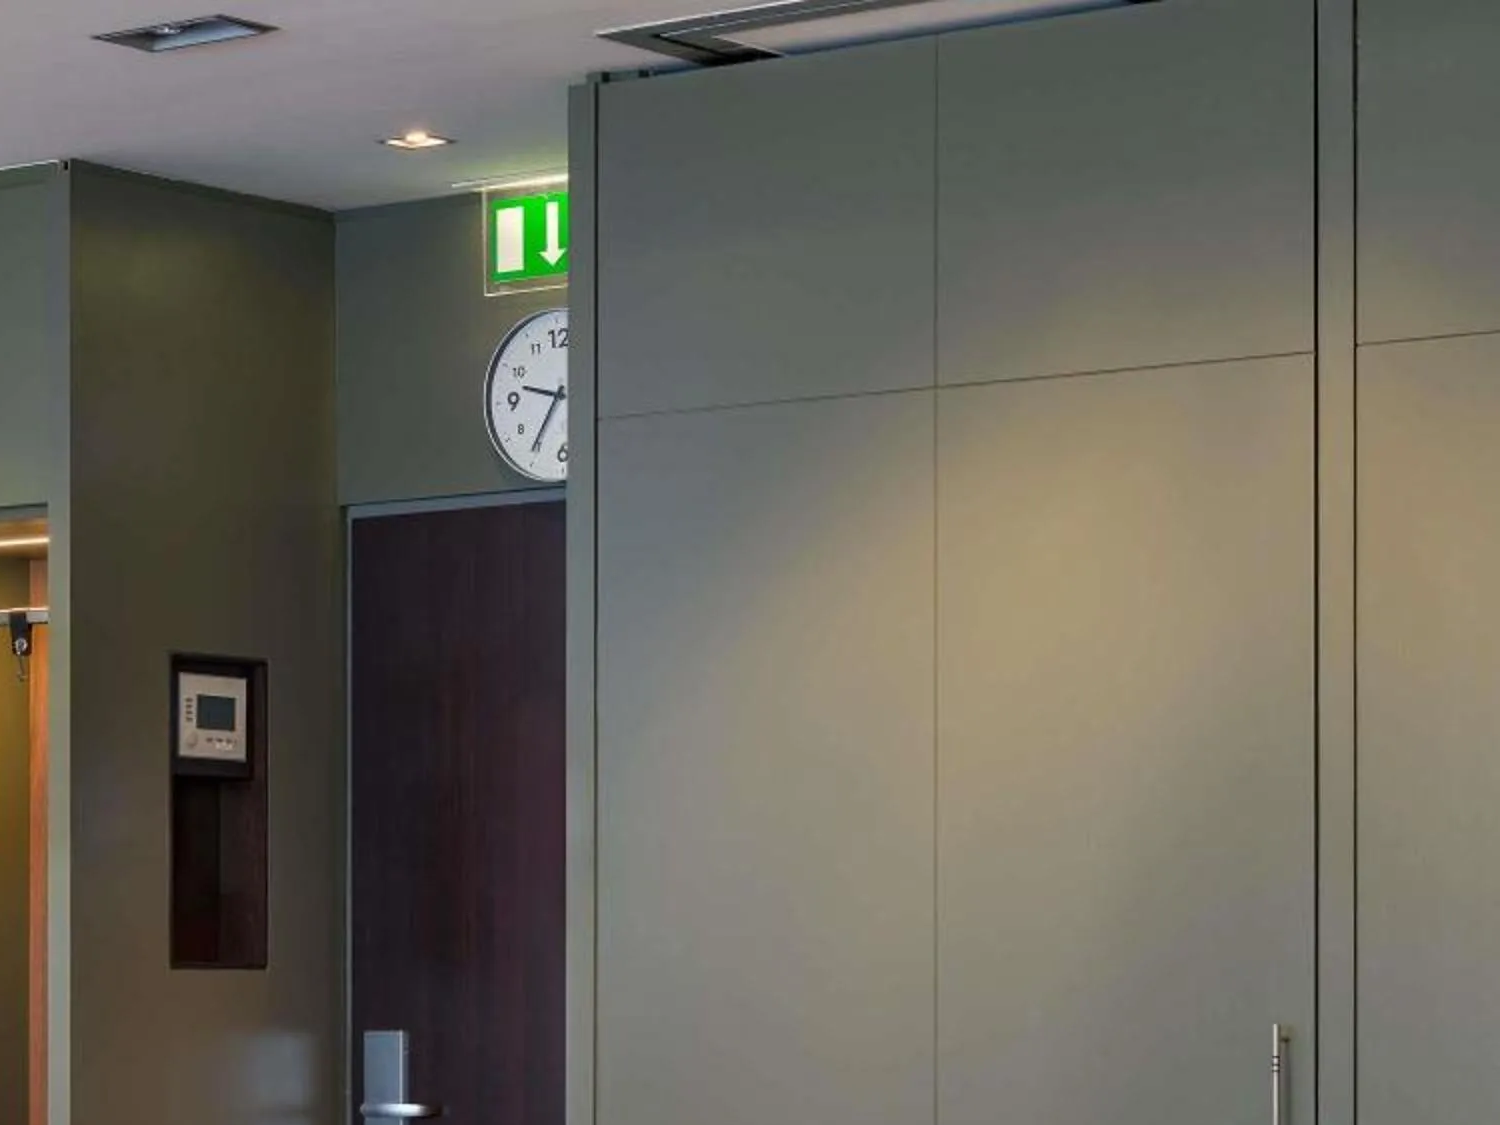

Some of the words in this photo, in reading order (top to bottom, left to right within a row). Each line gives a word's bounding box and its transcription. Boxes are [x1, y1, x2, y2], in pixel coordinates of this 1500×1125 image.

[548, 328, 569, 349] 12
[531, 343, 541, 355] 11
[512, 366, 525, 378] 10
[507, 391, 520, 412] 9
[517, 423, 525, 435] 8
[557, 441, 569, 463] 6
